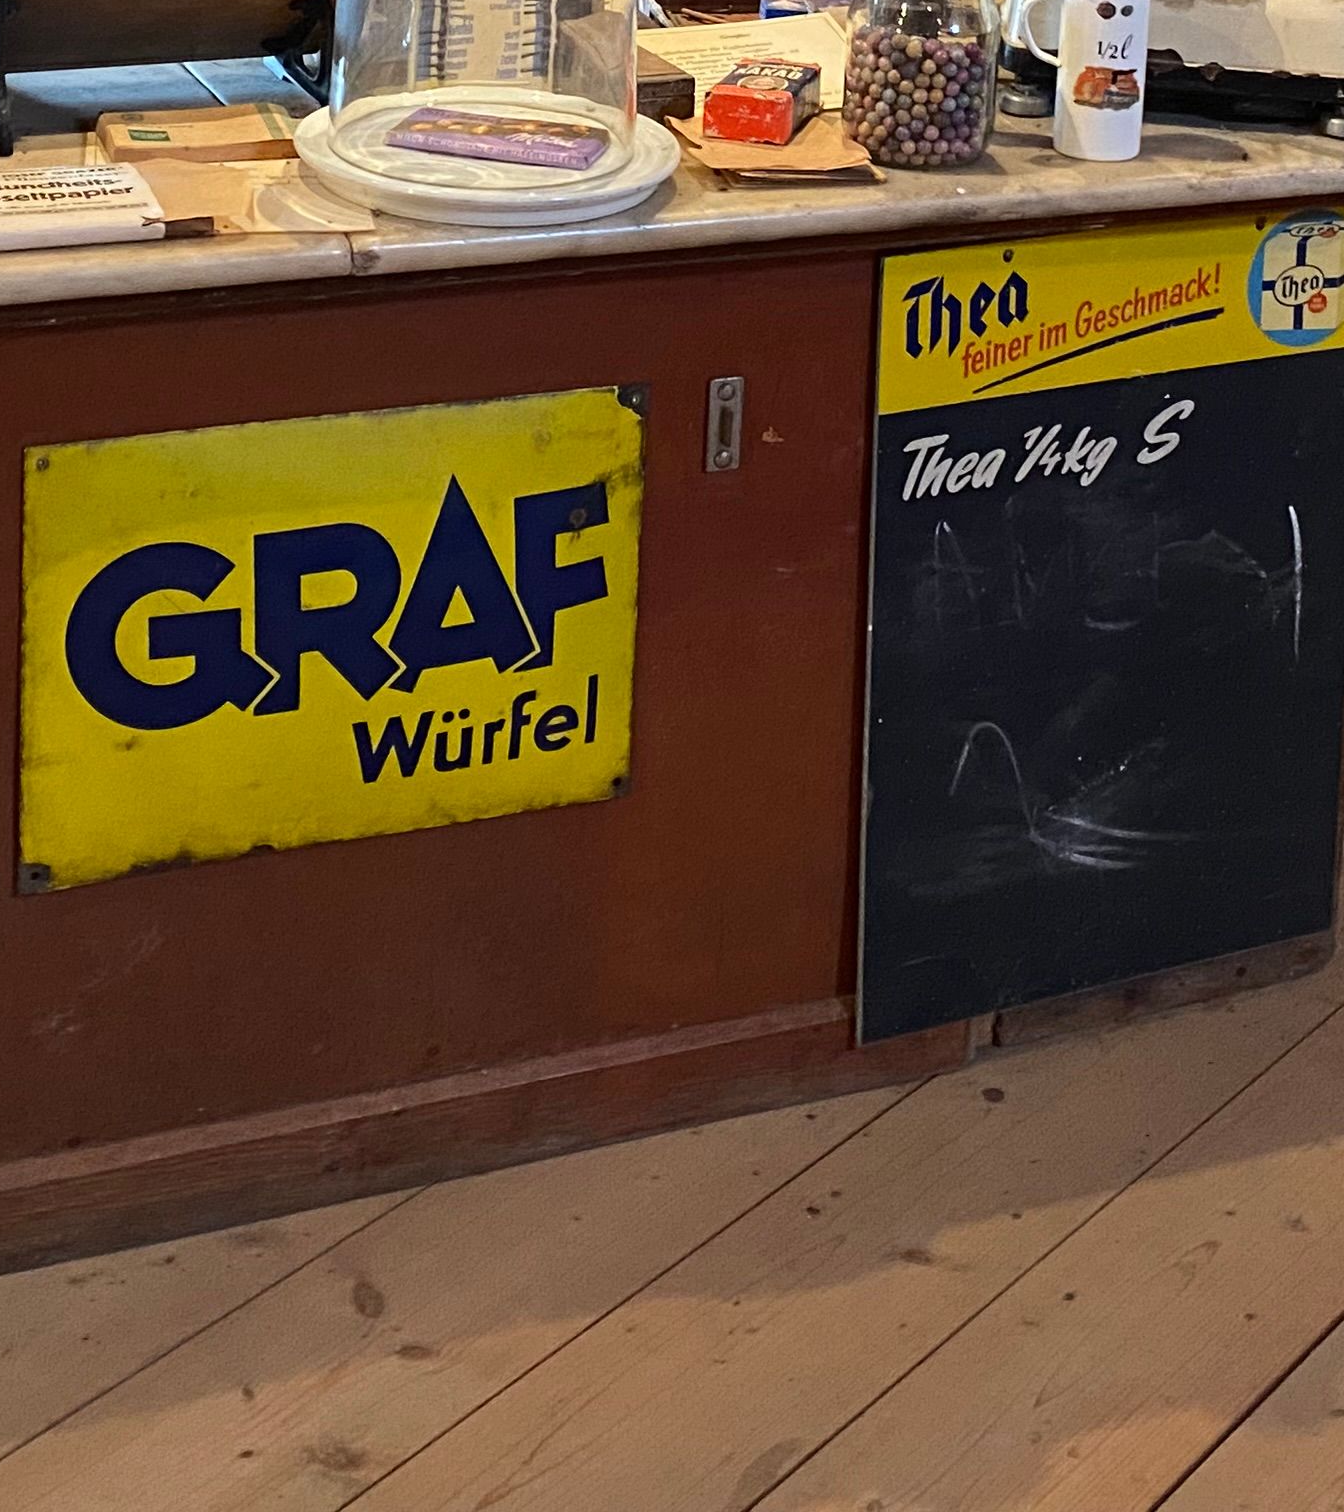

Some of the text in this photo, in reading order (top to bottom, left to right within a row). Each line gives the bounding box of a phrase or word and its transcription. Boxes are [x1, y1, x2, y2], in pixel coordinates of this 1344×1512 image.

[903, 271, 1029, 359] Thea
[961, 264, 1222, 378] feiner im Geschmack!
[1281, 273, 1321, 300] Thea
[902, 434, 1008, 502] Thea
[1136, 399, 1195, 465] S
[64, 474, 610, 731] GRAF
[351, 674, 600, 784] Würfel
